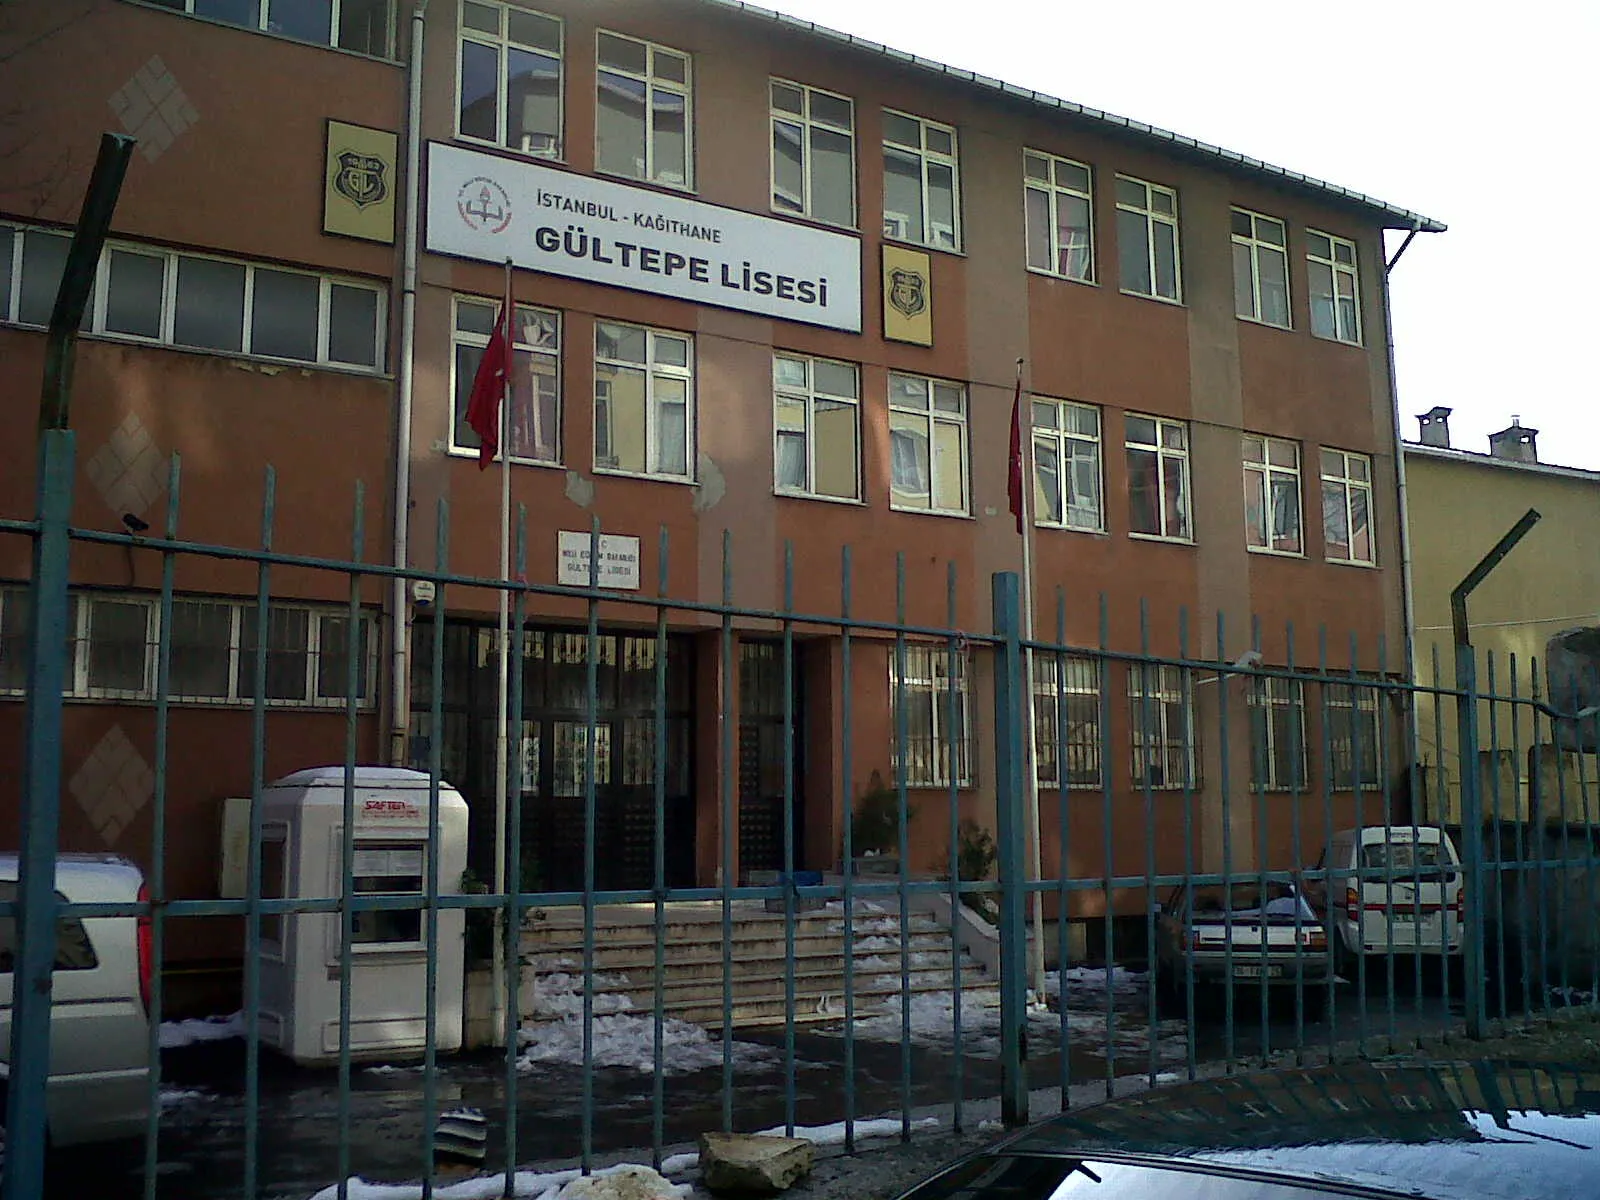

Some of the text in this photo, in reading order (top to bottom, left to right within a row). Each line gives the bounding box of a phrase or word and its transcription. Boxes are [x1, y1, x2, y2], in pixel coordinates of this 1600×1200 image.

[537, 188, 618, 222] İSTANBUL
[633, 211, 722, 244] KAĞITHANE
[535, 224, 828, 308] GÜLTEPE LİSESİ
